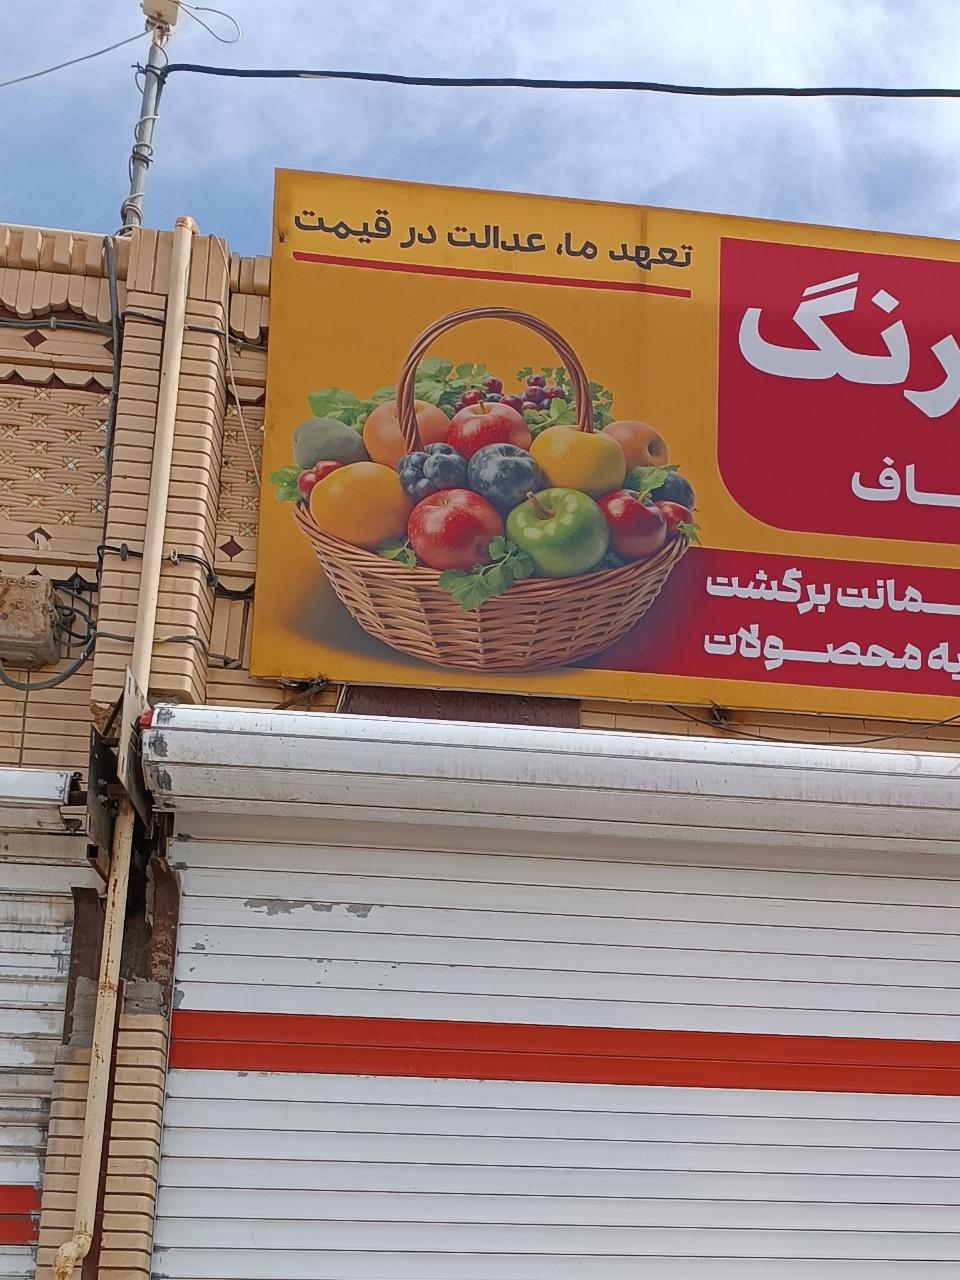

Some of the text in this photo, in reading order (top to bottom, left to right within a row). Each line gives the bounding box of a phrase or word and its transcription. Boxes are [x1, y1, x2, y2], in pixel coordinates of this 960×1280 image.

[293, 207, 393, 246] قیمت
[401, 224, 438, 250] در
[447, 223, 546, 254] عدالت
[609, 243, 692, 270] تعهد
[706, 566, 831, 615] برگشت
[703, 623, 922, 672] محصولات
